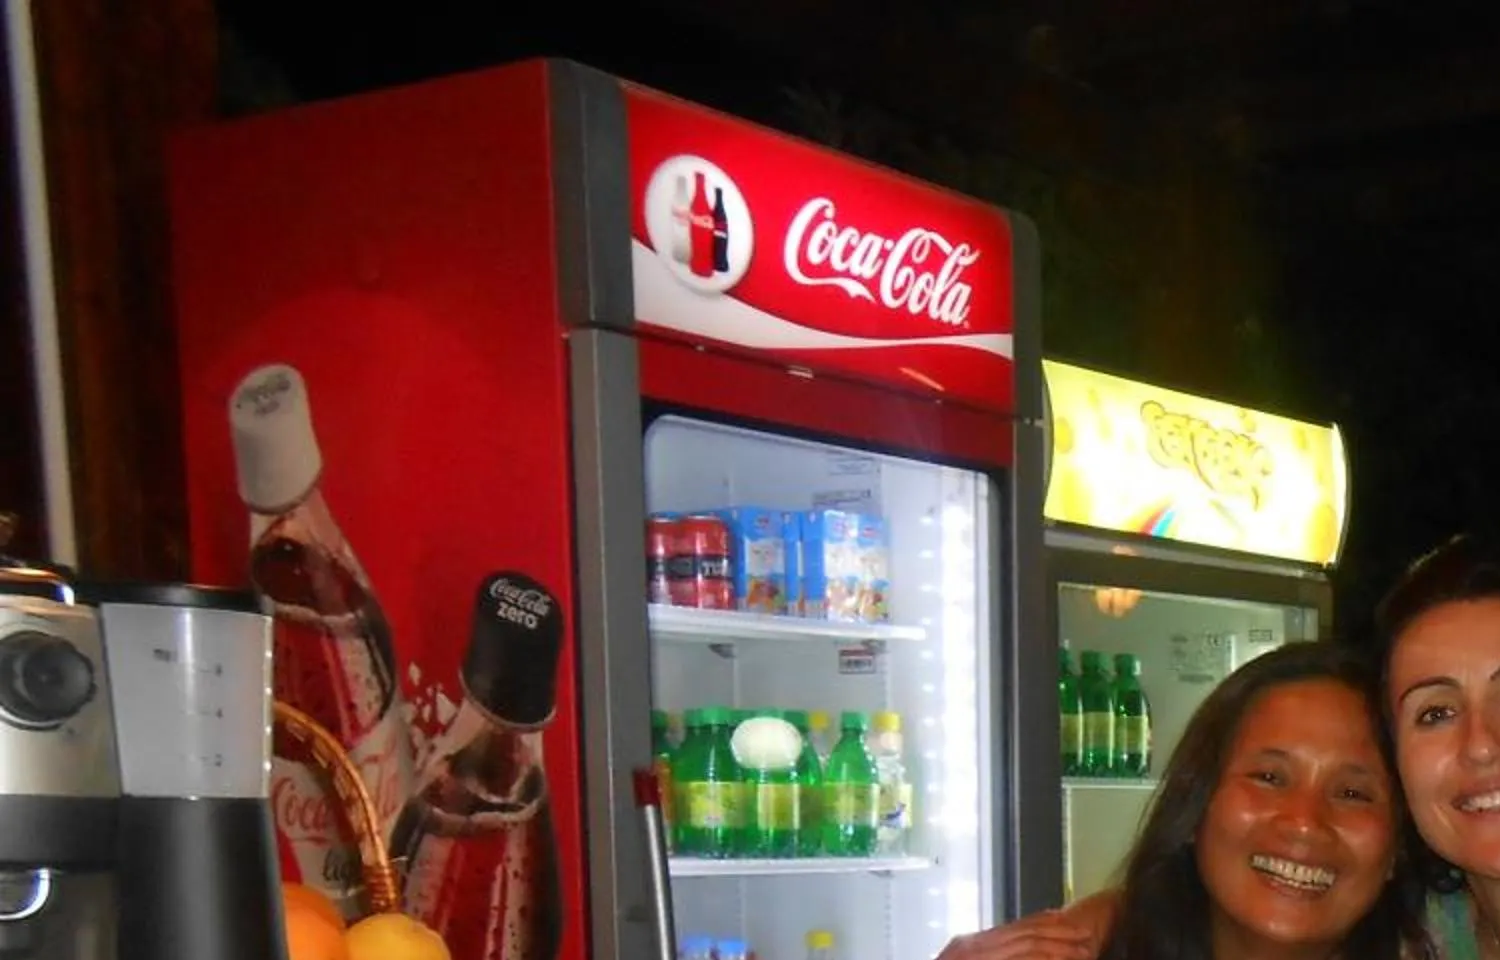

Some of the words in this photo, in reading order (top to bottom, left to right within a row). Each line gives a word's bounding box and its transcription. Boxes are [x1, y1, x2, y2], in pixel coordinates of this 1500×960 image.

[784, 197, 980, 325] Coca-Cola
[489, 578, 552, 617] Coca-Cola
[497, 601, 538, 629] zero
